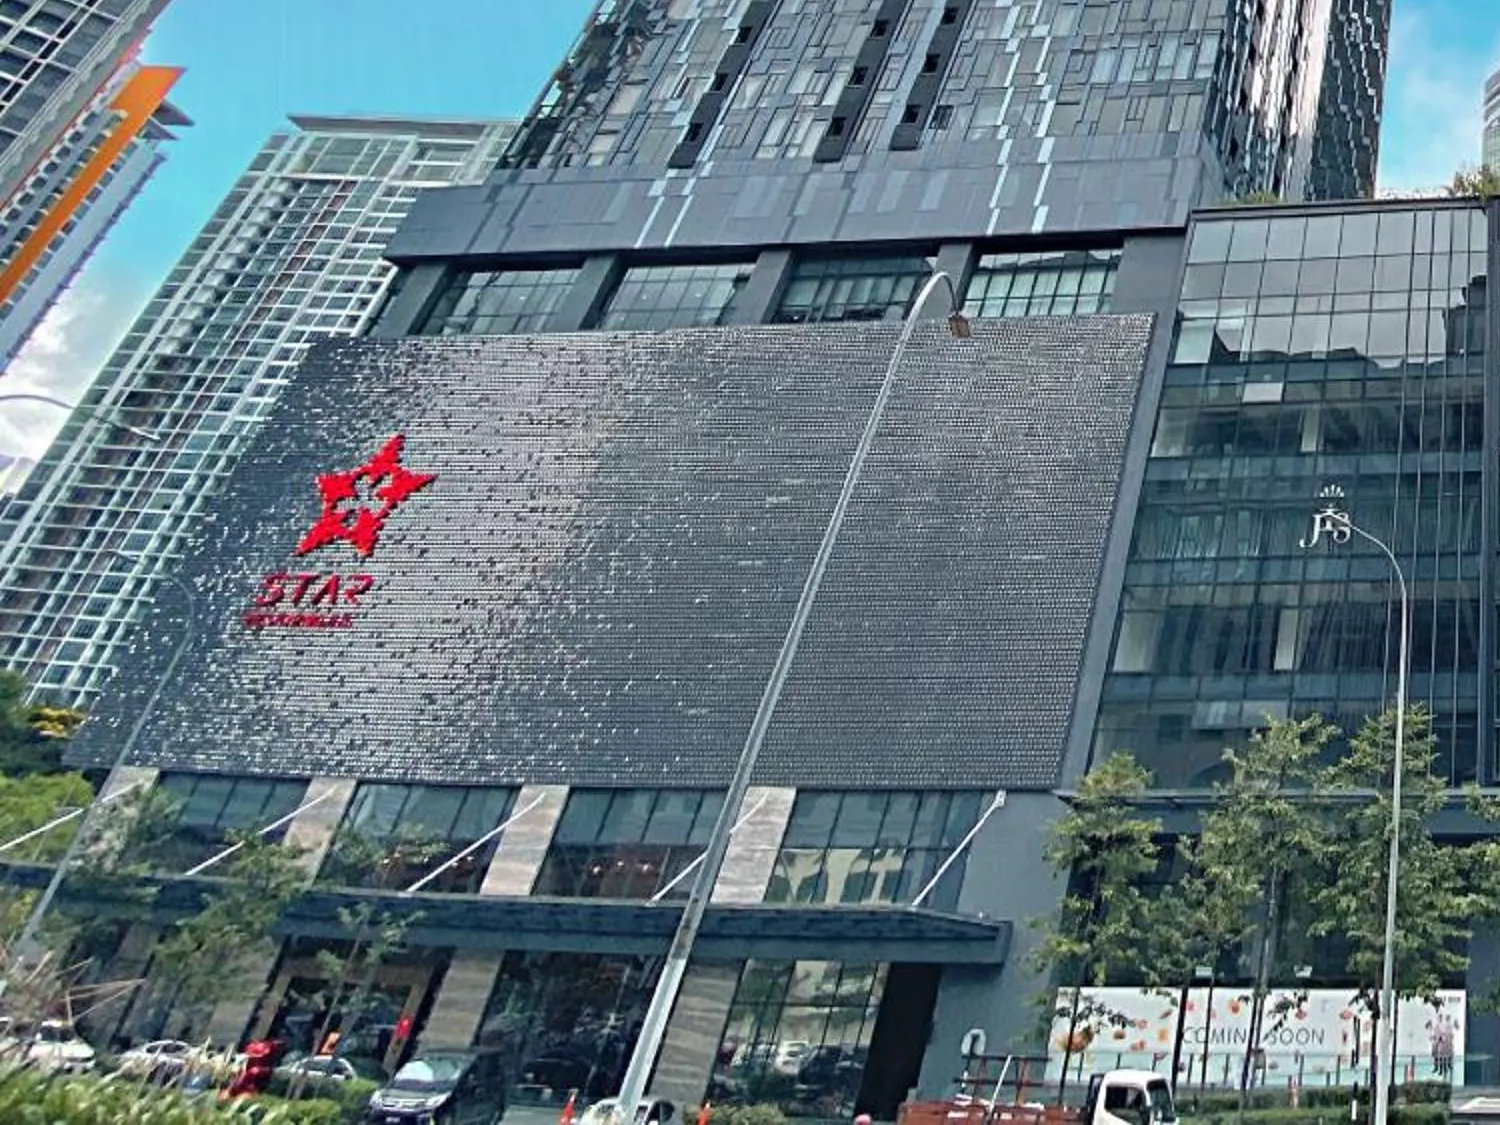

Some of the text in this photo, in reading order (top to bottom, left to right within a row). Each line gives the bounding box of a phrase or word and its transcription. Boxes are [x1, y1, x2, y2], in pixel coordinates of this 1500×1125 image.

[256, 573, 374, 606] STAR
[1182, 1026, 1325, 1046] COMIN SOON
